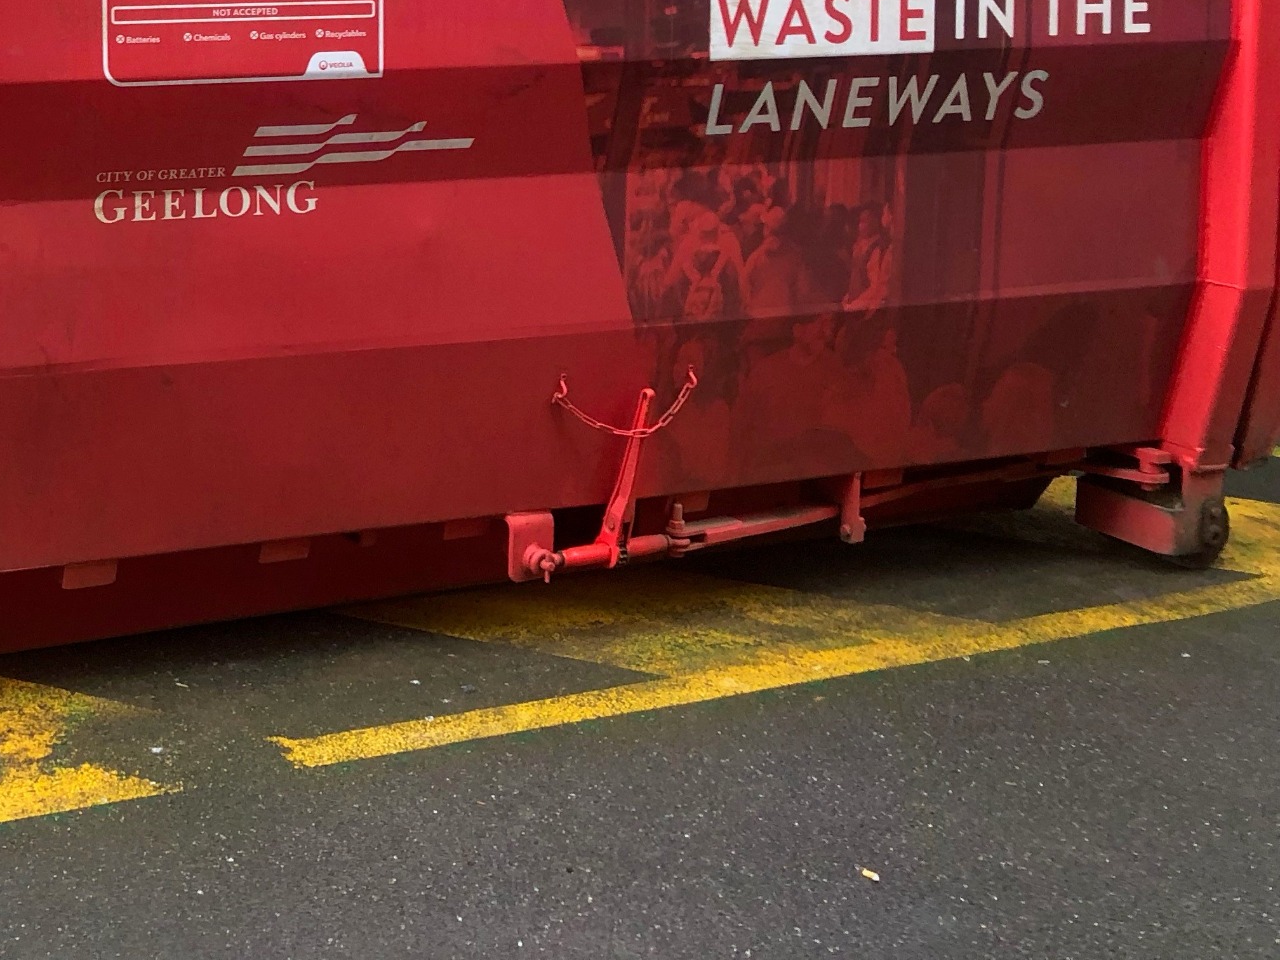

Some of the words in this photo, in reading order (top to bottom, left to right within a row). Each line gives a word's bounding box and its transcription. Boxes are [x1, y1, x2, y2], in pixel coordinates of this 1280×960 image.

[212, 8, 231, 16] NOT
[233, 7, 279, 16] ACCEPTED
[126, 35, 160, 43] Batteries
[193, 33, 231, 42] Chemicals
[260, 32, 274, 40] Gas
[275, 31, 306, 41] cylinders
[325, 29, 367, 39] Recyclables
[704, 69, 1050, 135] LANEWAYS
[96, 170, 133, 184] CITY
[136, 169, 156, 182] OF
[158, 167, 226, 180] GREATER
[93, 180, 319, 224] GEELONG
